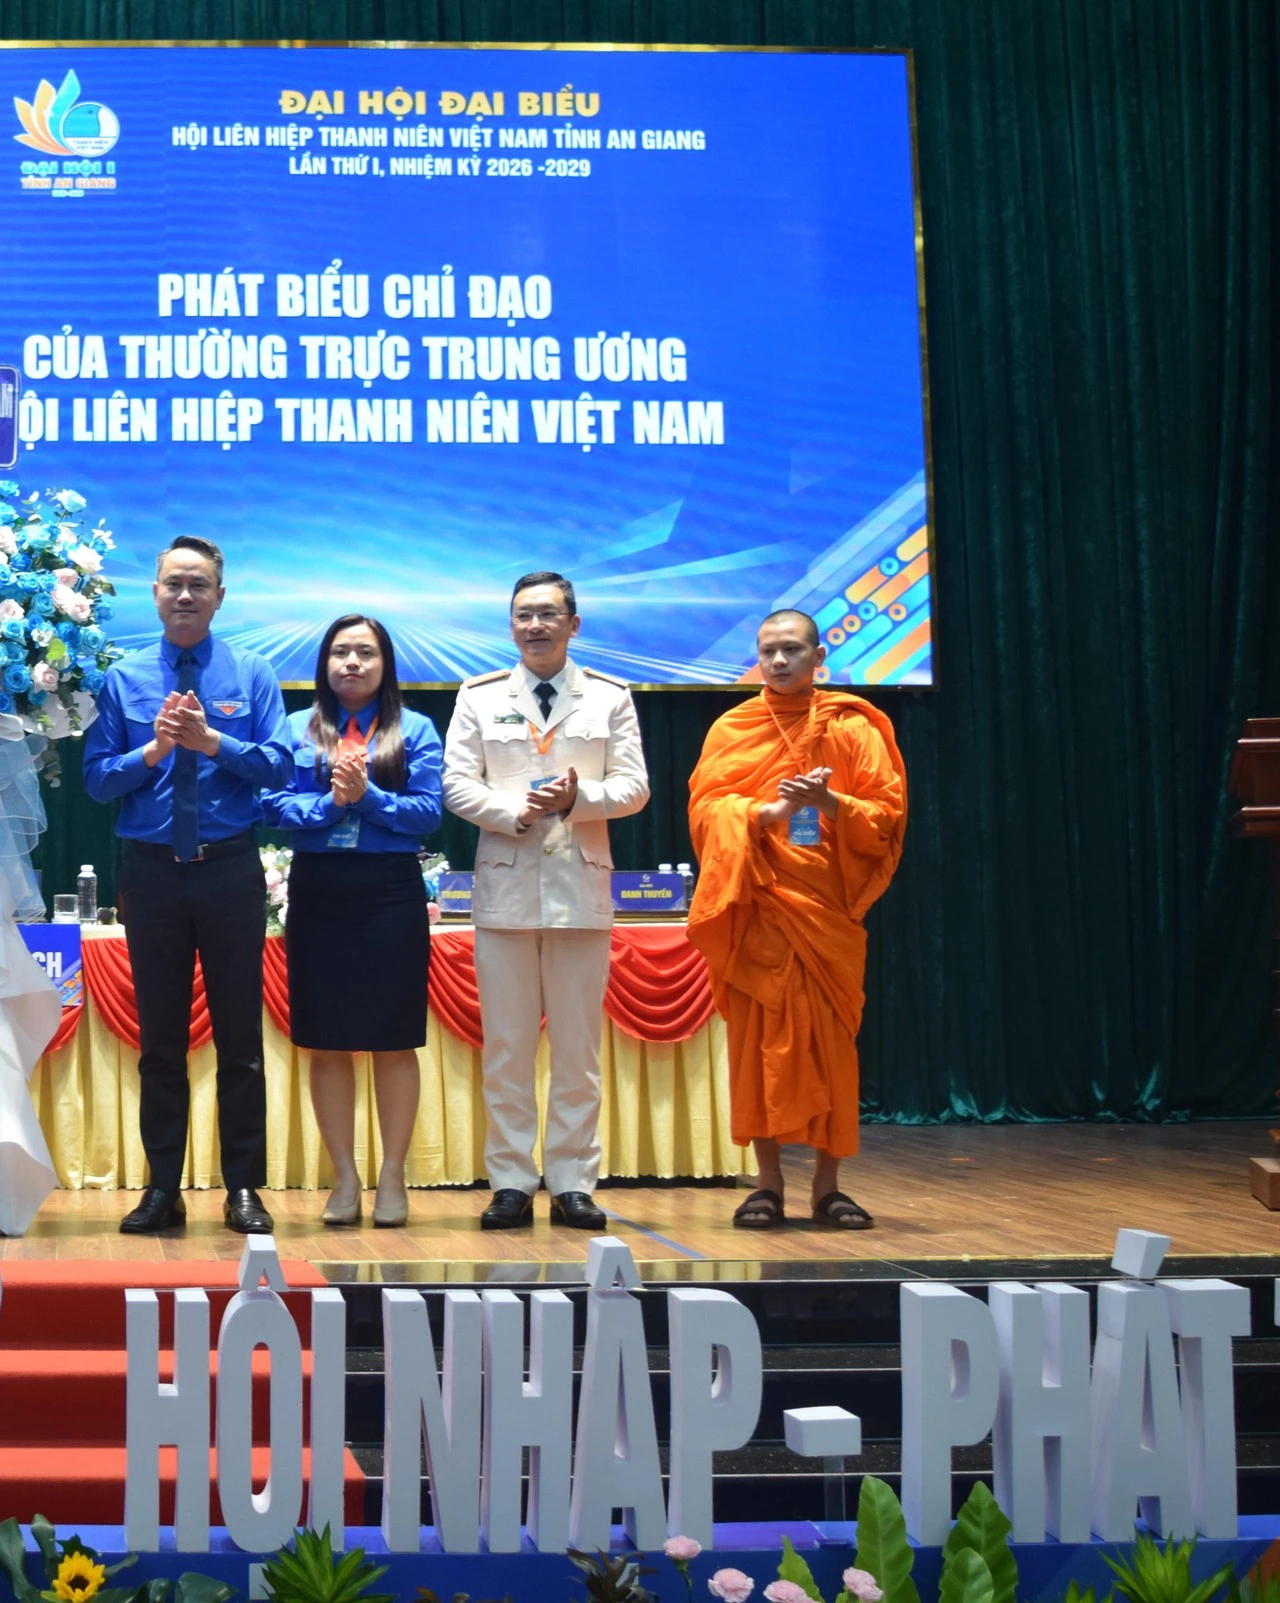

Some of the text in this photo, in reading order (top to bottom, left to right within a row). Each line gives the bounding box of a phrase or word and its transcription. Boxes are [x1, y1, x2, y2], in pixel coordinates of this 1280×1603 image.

[278, 84, 600, 122] ĐẠI HỘI ĐẠI BIỂU
[172, 123, 705, 151] HỘI LIÊN HIỆP THANH NIÊN VIỆT NAM TỈNH AN GIANG
[21, 161, 58, 177] ĐẠI
[63, 159, 101, 177] HỘI
[332, 154, 369, 175] THỨ
[373, 158, 384, 177] I,
[390, 155, 451, 179] NHIỆM
[457, 155, 481, 176] KỲ
[487, 159, 532, 176] 2026
[53, 178, 73, 189] AN
[75, 178, 116, 189] GIANG
[158, 260, 552, 328] PHÁT BIỂU CHỈ ĐẠO
[23, 325, 687, 387] CỦA THƯỜNG TRỰC TRUNG ƯƠNG
[19, 390, 725, 452] ỘI LIÊN HIỆP THANH NIÊN VIỆT NAM
[32, 951, 62, 978] CH
[901, 1228, 1251, 1546] PHÁT
